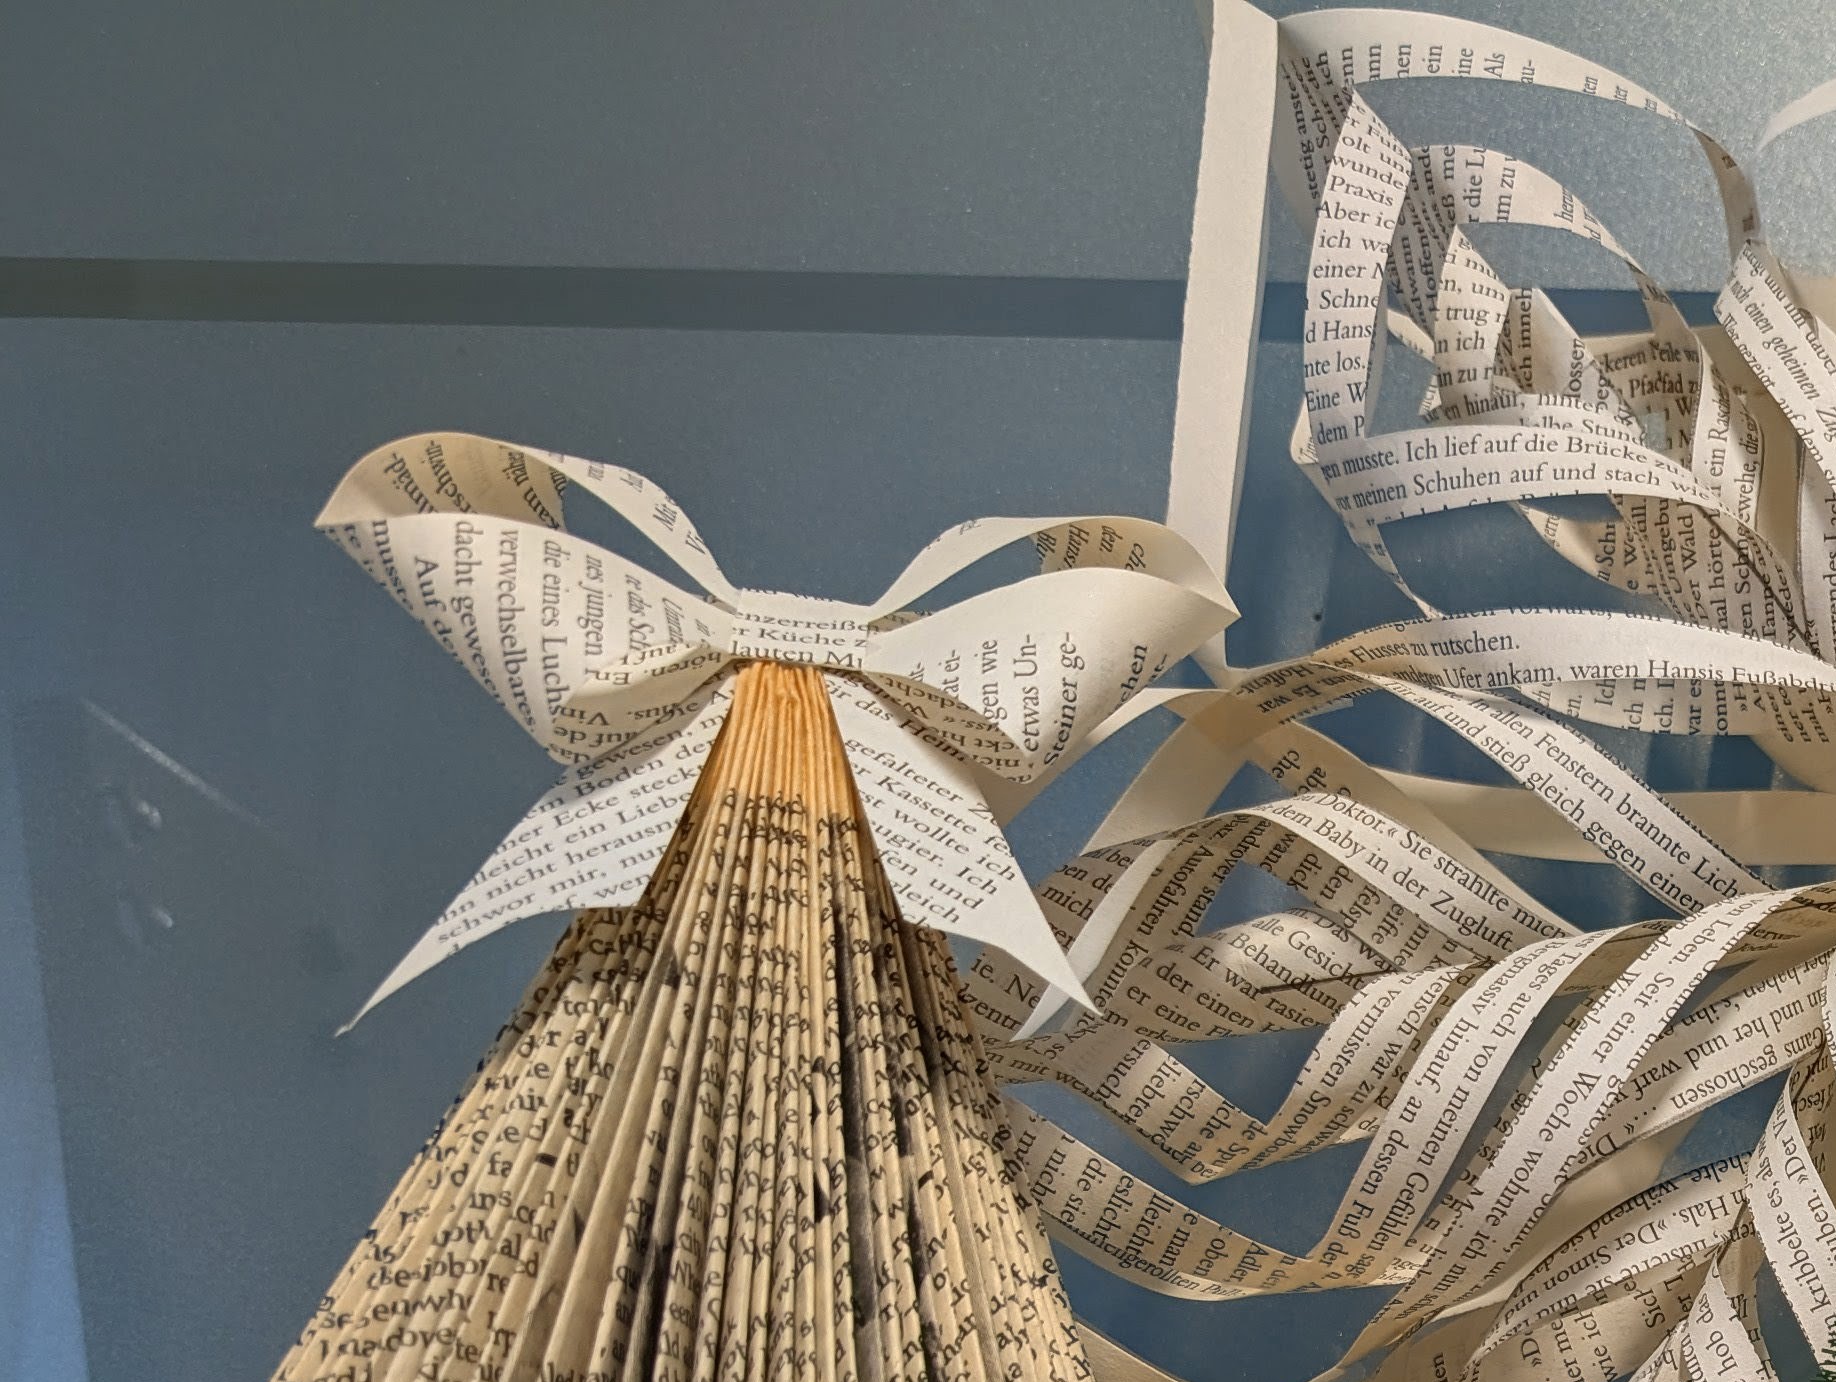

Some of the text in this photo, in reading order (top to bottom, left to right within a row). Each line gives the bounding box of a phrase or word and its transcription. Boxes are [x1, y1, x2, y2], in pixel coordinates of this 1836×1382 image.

[1329, 174, 1394, 207] Praxis
[1312, 261, 1367, 280] einer
[1769, 334, 1819, 402] geheimen
[1343, 432, 1648, 481] musste. Ich lief auf die Brücke
[1352, 459, 1662, 509] meinen Schuhen auf und stach
[414, 554, 443, 613] Auf
[455, 520, 484, 588] dacht
[544, 540, 570, 627] die eines
[498, 529, 538, 734] verwechselbares.
[581, 582, 605, 658] jungen
[758, 628, 848, 647] Küche
[1350, 628, 1522, 667] Flusses rutschen.
[975, 639, 998, 674] wie
[1487, 659, 1724, 690] ankam, waren Hansis
[1012, 634, 1040, 753] etwas Un-
[1043, 669, 1078, 766] Steiner
[572, 762, 663, 806] Boden
[577, 729, 672, 780] gewesen,
[845, 740, 963, 803] gefalteter
[1445, 708, 1587, 823] und stieß gleich
[562, 797, 608, 824] Ecke
[875, 776, 978, 837] Kassette
[1532, 725, 1689, 866] Fenstern brannte
[565, 825, 606, 845] ein
[894, 809, 1016, 883] wollte ich
[1319, 792, 1509, 911] Doktor.« Sie strahlte
[437, 845, 669, 943] schwor mir, nur
[494, 872, 553, 907] nicht
[929, 878, 984, 911] und
[956, 865, 999, 895] Ich
[1041, 884, 1096, 919] mich
[1141, 846, 1216, 936] Autofahren
[1314, 818, 1515, 953] Baby in der Zugluft.
[1319, 988, 1401, 1088] vermissten
[1685, 1039, 1730, 1070] und
[1485, 971, 1674, 1225] Seit einer Woche wohnte
[1672, 1044, 1777, 1110] geschossen
[1339, 1016, 1479, 1239] hinauf, an dessen Fuß
[1380, 993, 1531, 1256] auch von meinen Gefühlen
[1671, 1197, 1730, 1228] Hals.
[1775, 1211, 1832, 1312] kribbelte
